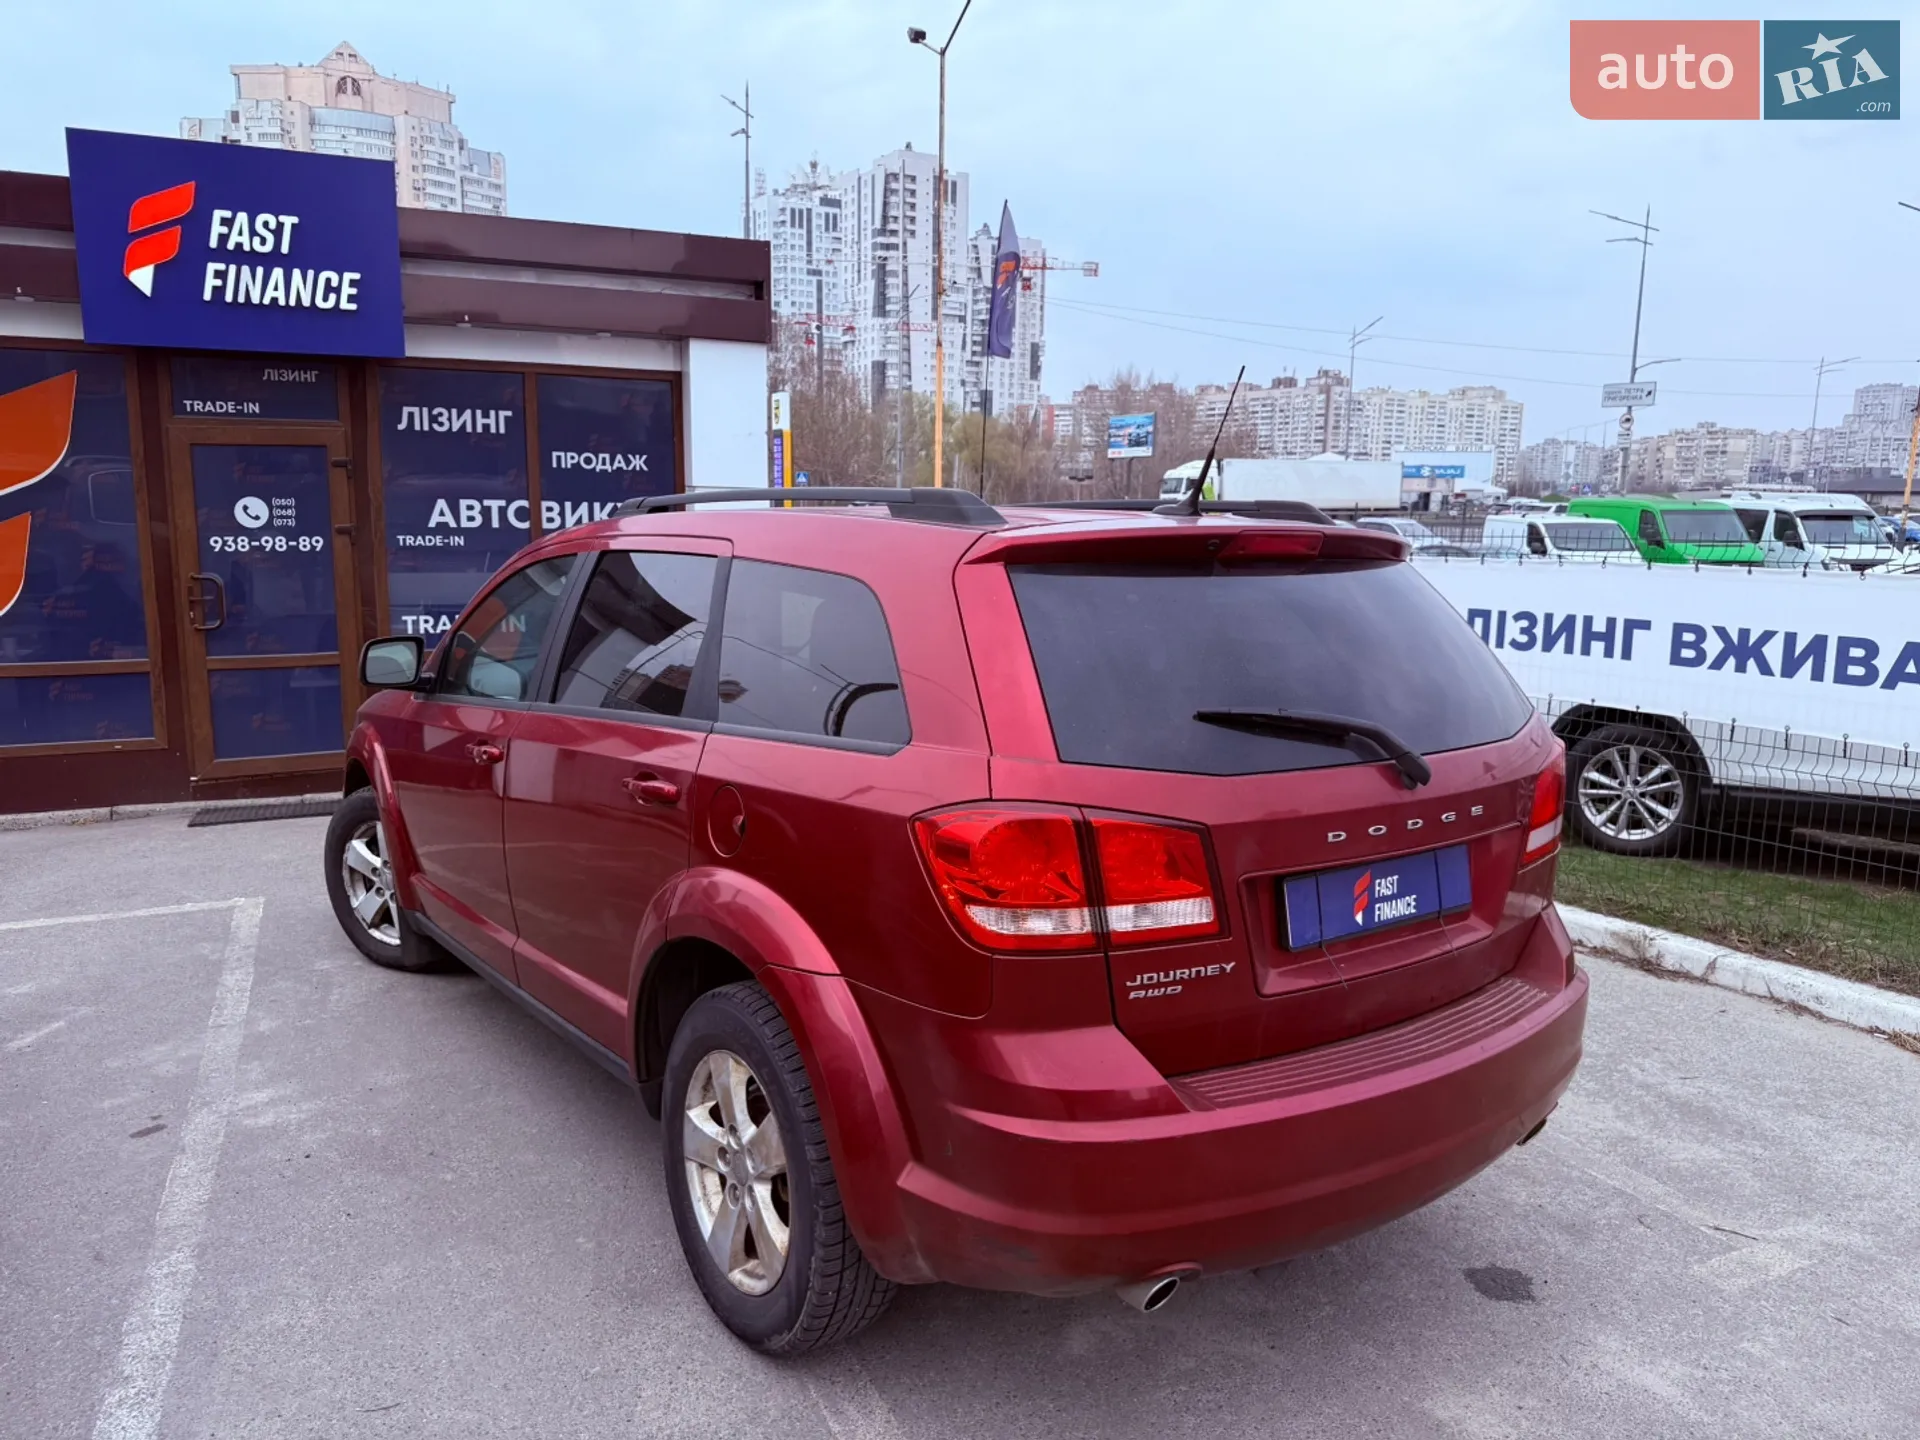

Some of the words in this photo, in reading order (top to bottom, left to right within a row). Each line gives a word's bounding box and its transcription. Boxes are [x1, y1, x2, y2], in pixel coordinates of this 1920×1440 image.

[208, 209, 300, 254] FAST
[203, 262, 361, 311] FINANCE
[262, 368, 320, 383] ЛІЗИНГ
[183, 399, 261, 414] TRADE-IN
[397, 406, 513, 434] ЛІЗИНГ
[551, 450, 649, 472] ПРОДАЖ
[273, 517, 296, 527] (073)
[209, 535, 324, 552] 938-98-89
[396, 535, 465, 547] TRADE-IN
[1327, 804, 1484, 843] DODGE
[1374, 875, 1399, 899] FAST
[1374, 895, 1418, 923] FINANCE
[1125, 961, 1236, 987] JOURNEY
[1128, 985, 1183, 1000] AWD
